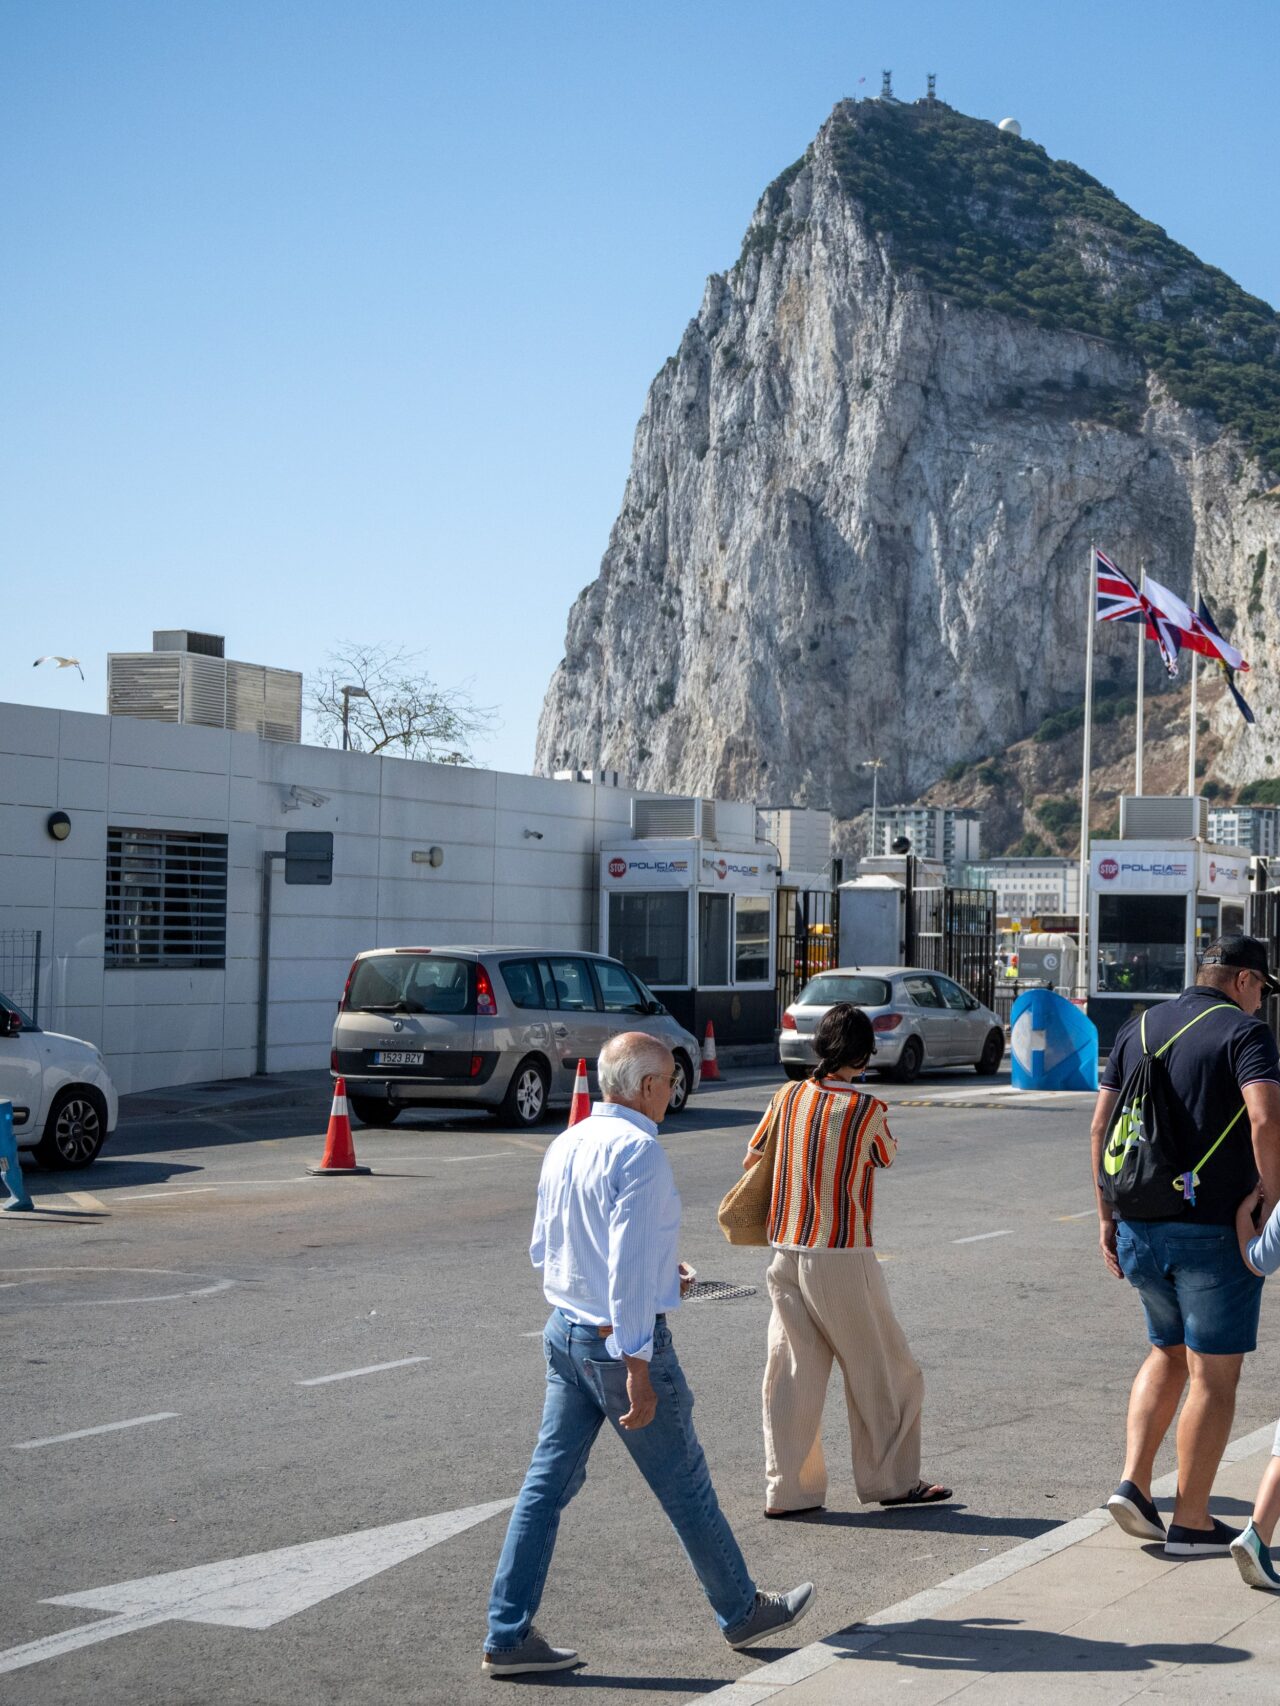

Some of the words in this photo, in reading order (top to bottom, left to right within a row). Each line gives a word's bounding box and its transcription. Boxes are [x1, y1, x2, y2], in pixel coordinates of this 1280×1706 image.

[609, 863, 625, 873] STOP
[628, 861, 674, 869] POLICIA
[1100, 864, 1118, 874] STOP
[1121, 864, 1173, 872] POLICIA
[383, 1052, 403, 1063] 1523
[405, 1053, 422, 1064] BZY
